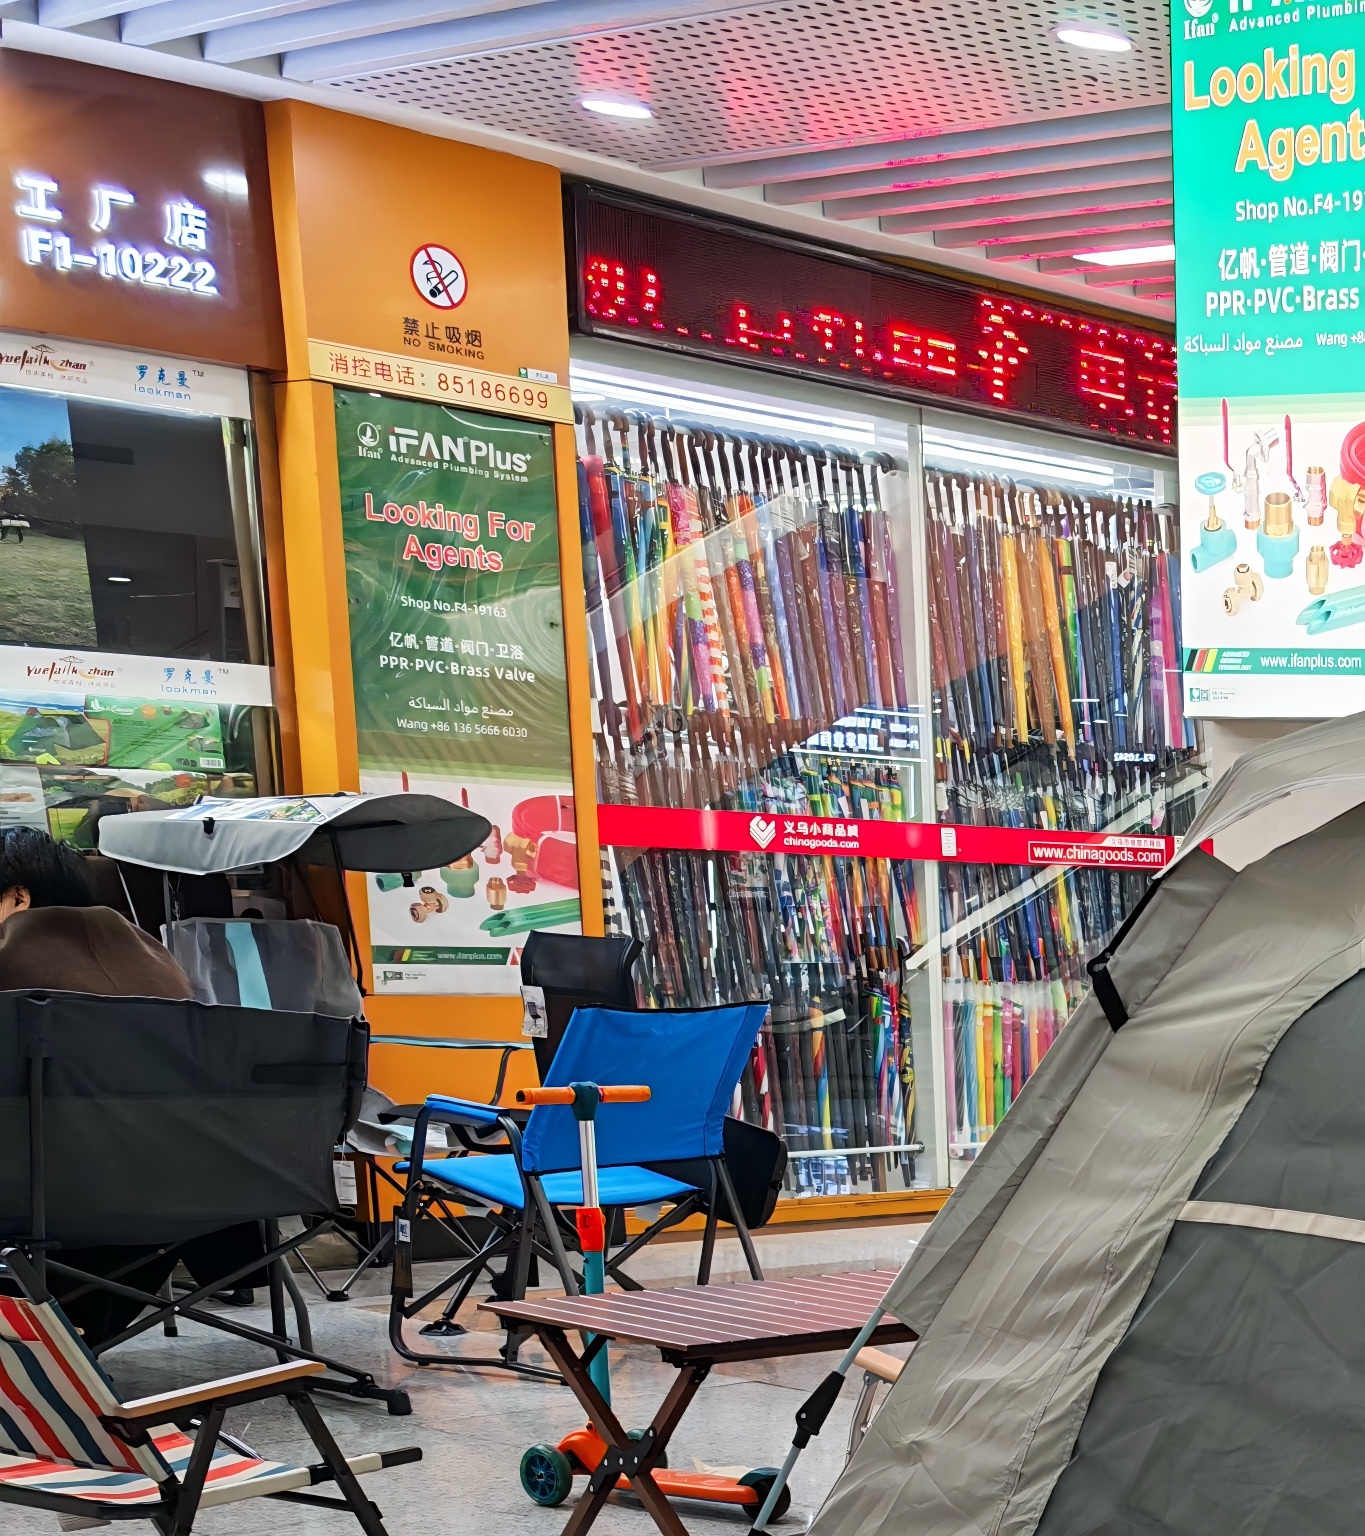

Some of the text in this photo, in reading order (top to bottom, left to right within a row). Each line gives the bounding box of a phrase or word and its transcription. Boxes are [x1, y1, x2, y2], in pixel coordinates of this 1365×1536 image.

[1229, 9, 1300, 33] Advanced
[1184, 43, 1355, 111] Looking
[15, 172, 208, 251] 工厂店
[1235, 200, 1279, 223] Shop
[23, 228, 221, 297] F1-10222
[402, 316, 483, 348] 禁止吸烟
[1233, 331, 1261, 356] مواد
[1315, 331, 1348, 348] Wang
[403, 337, 485, 361] NO SMOKING
[1265, 335, 1304, 356] مصنع
[135, 364, 191, 389] 罗克曼
[134, 384, 191, 400] lookman
[437, 372, 549, 409] 85186699
[390, 453, 439, 469] Advanced
[443, 462, 489, 479] Plumbing
[364, 492, 536, 543] Looking For
[402, 533, 503, 572] Agents
[401, 595, 507, 618] Shop No.F4-19163
[1260, 652, 1362, 671] www.ifanplus.com
[494, 667, 536, 683] Valve
[161, 684, 217, 696] lookman
[396, 717, 428, 732] Wang
[453, 722, 472, 734] 136
[783, 836, 860, 849] chinagoods.com
[1033, 845, 1162, 864] www.chinagoods.com
